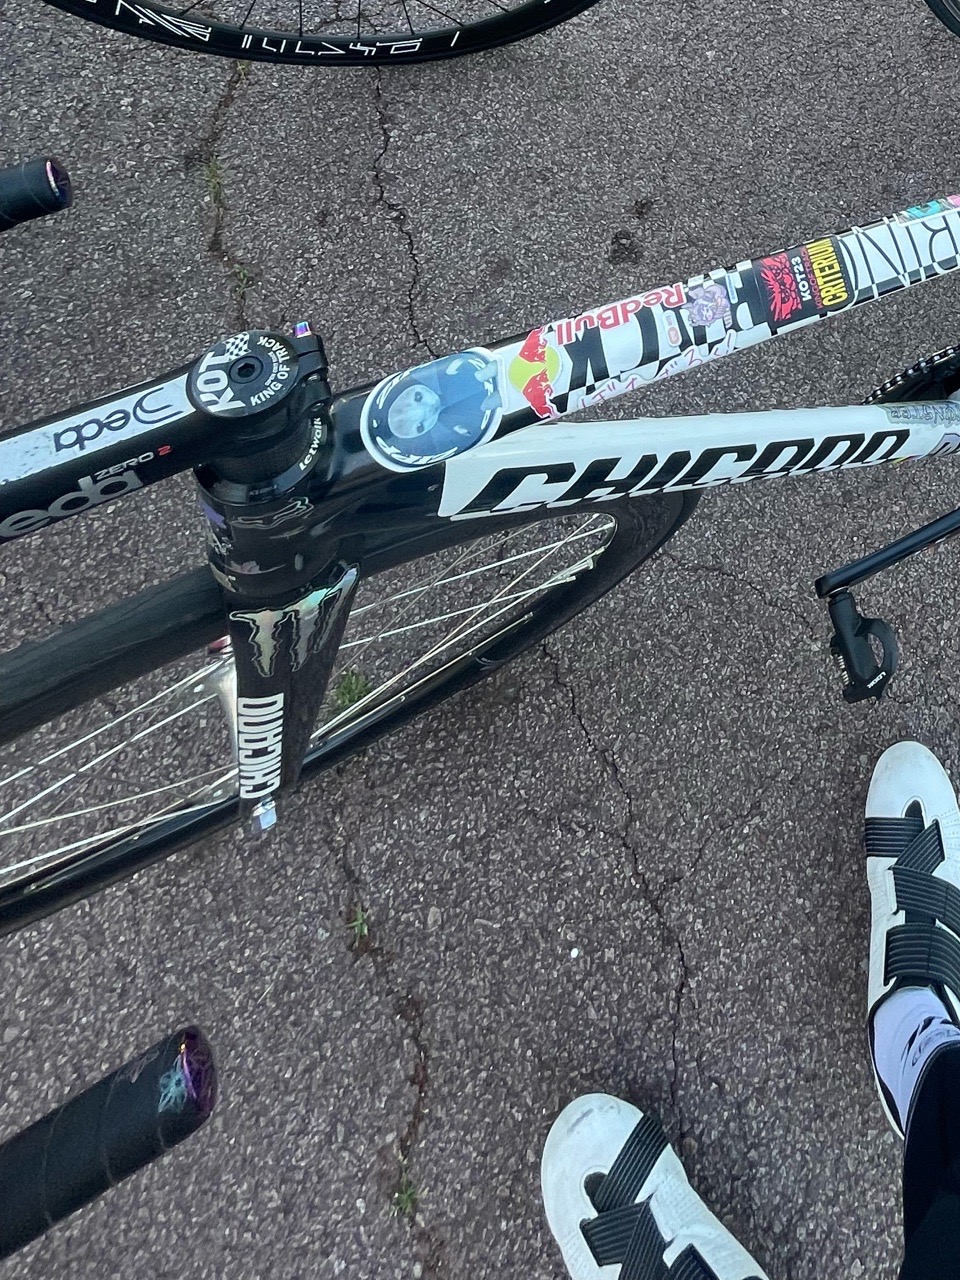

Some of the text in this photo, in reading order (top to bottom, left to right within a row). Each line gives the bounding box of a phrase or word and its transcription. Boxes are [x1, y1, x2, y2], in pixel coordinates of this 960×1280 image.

[791, 256, 812, 301] KOT23
[806, 238, 848, 306] CRITERIUM
[556, 282, 686, 346] RedBull
[256, 336, 291, 365] TRACK
[276, 364, 291, 381] OF
[196, 351, 246, 413] KOT
[250, 381, 283, 407] KING
[94, 445, 172, 480] ZERO 2
[0, 470, 144, 538] eda
